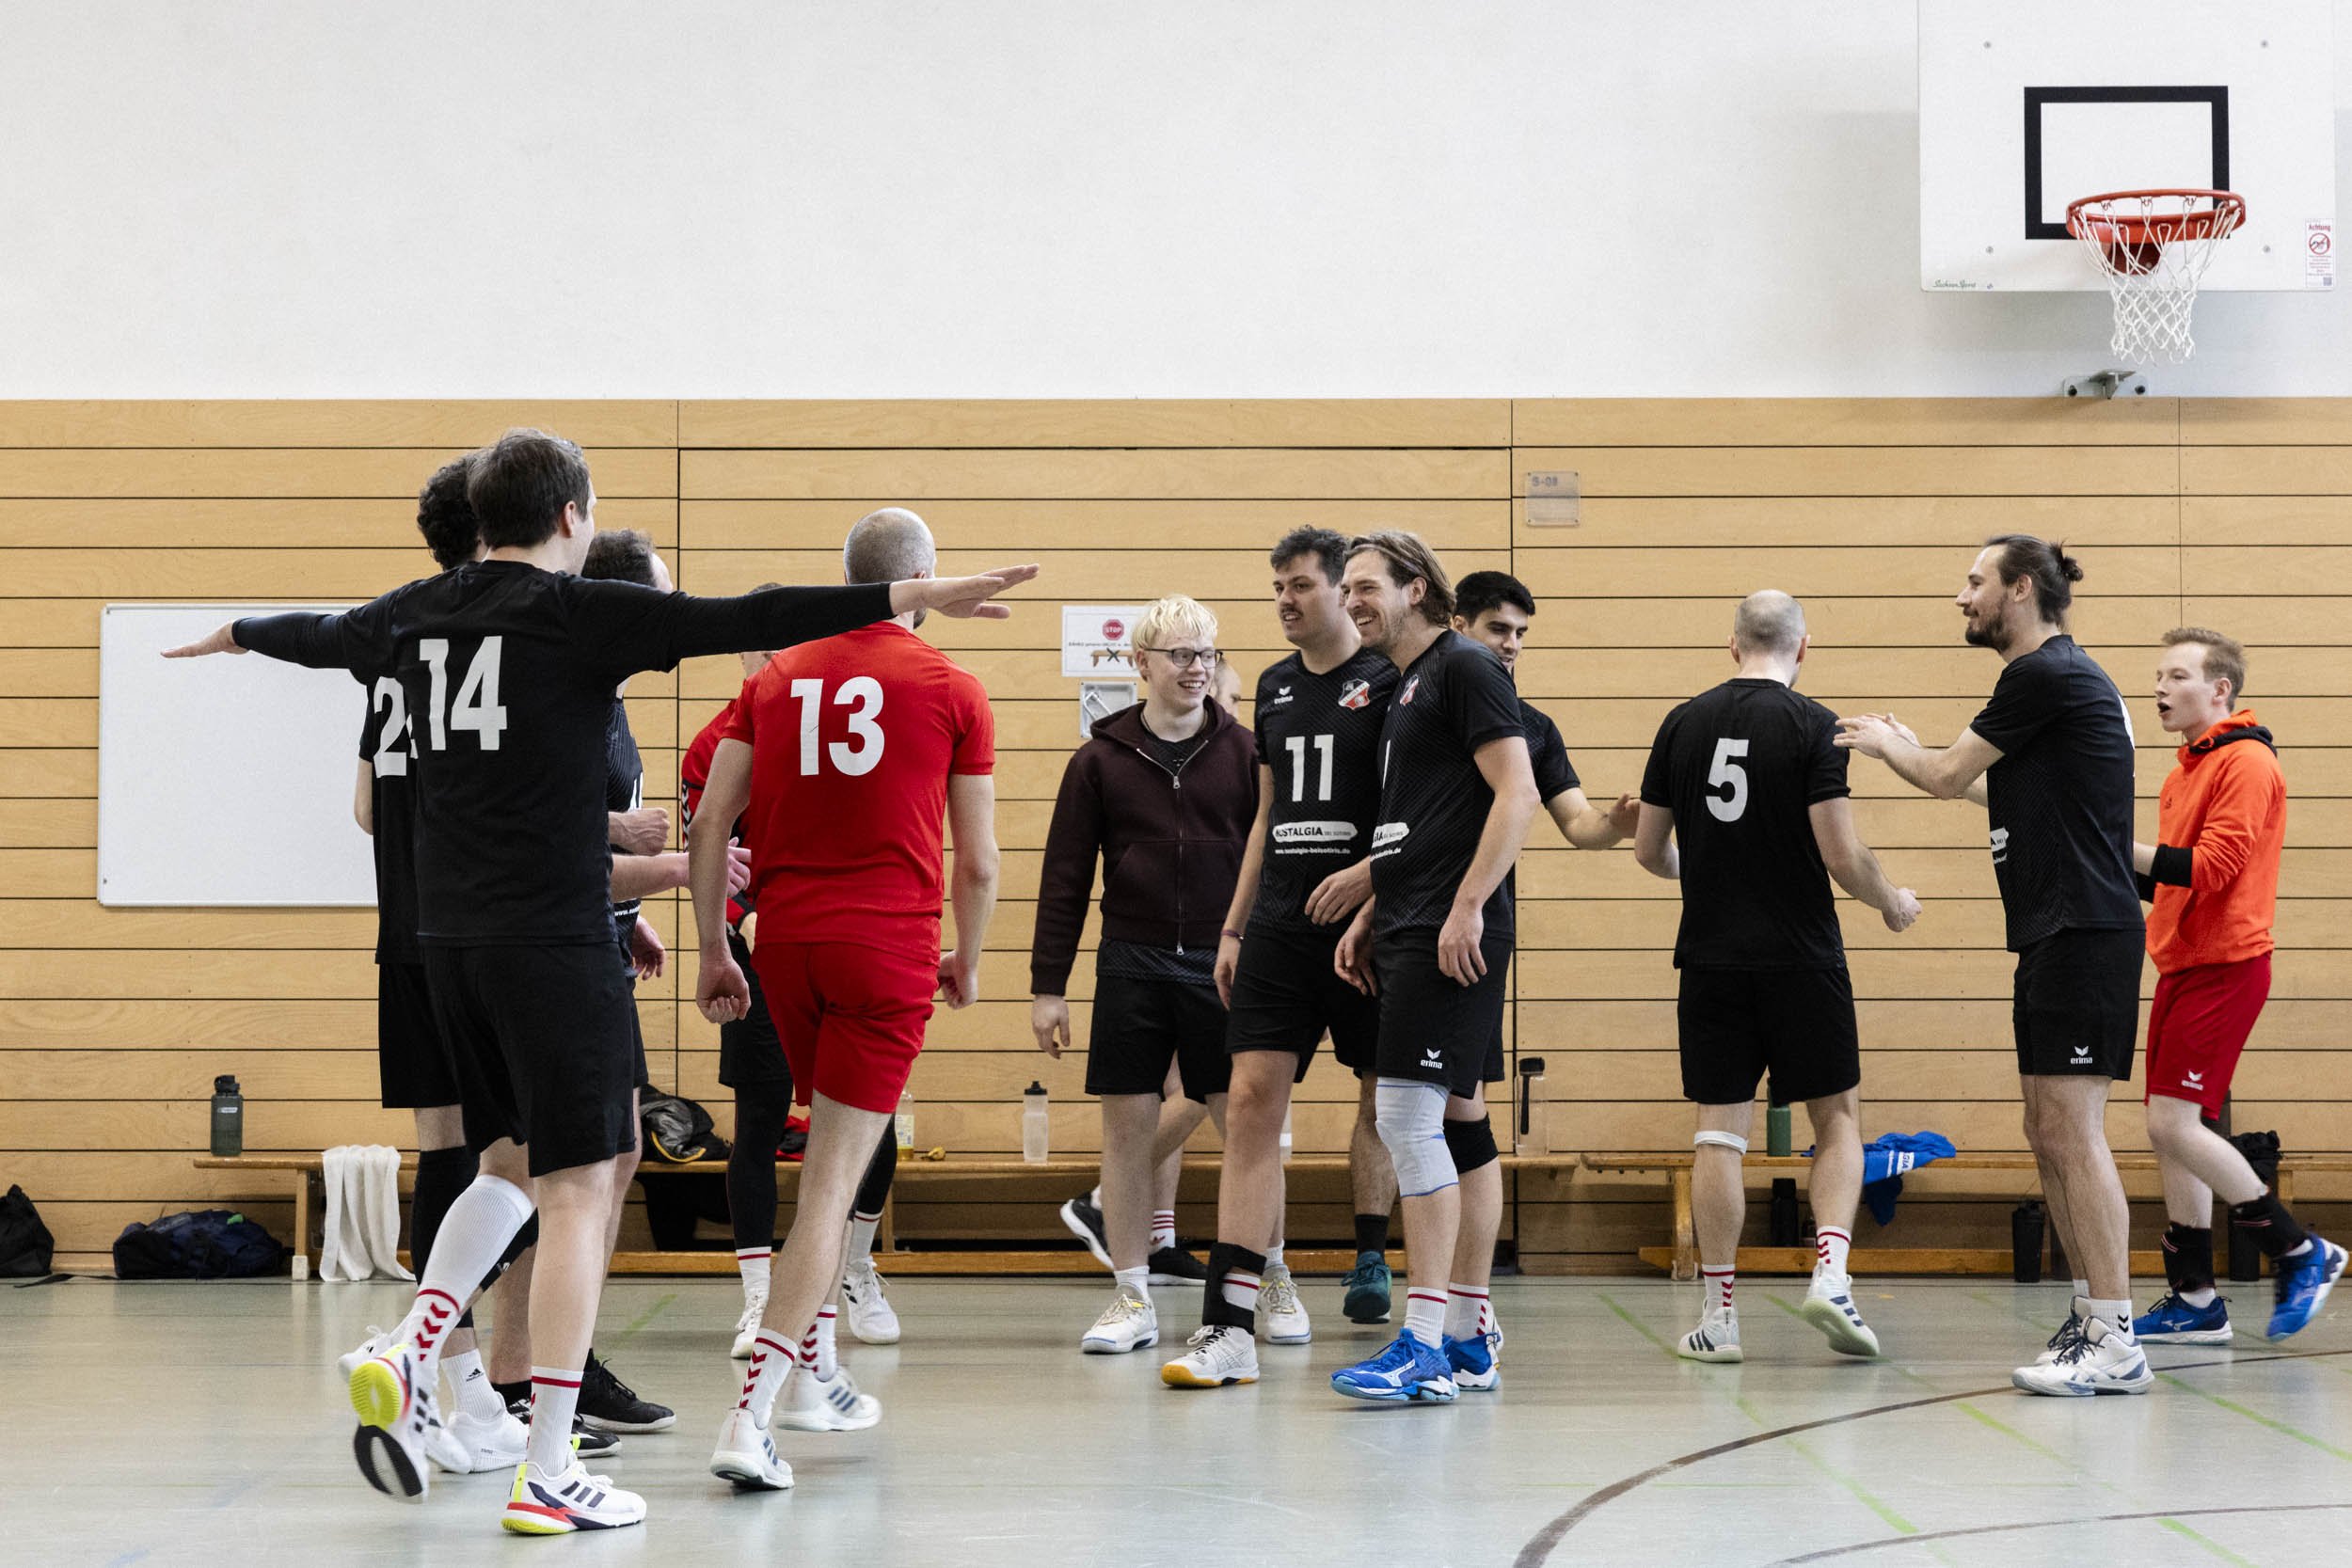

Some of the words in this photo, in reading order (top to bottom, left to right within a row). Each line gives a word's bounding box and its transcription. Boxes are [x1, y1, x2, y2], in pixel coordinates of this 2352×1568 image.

[2308, 224, 2331, 232] Achtung
[373, 675, 419, 779] 2
[419, 635, 508, 751] 14
[790, 675, 885, 777] 13
[1285, 734, 1334, 802] 11
[1706, 737, 1750, 823] 5
[1420, 1059, 1443, 1069] erima
[2070, 1056, 2093, 1065] erima
